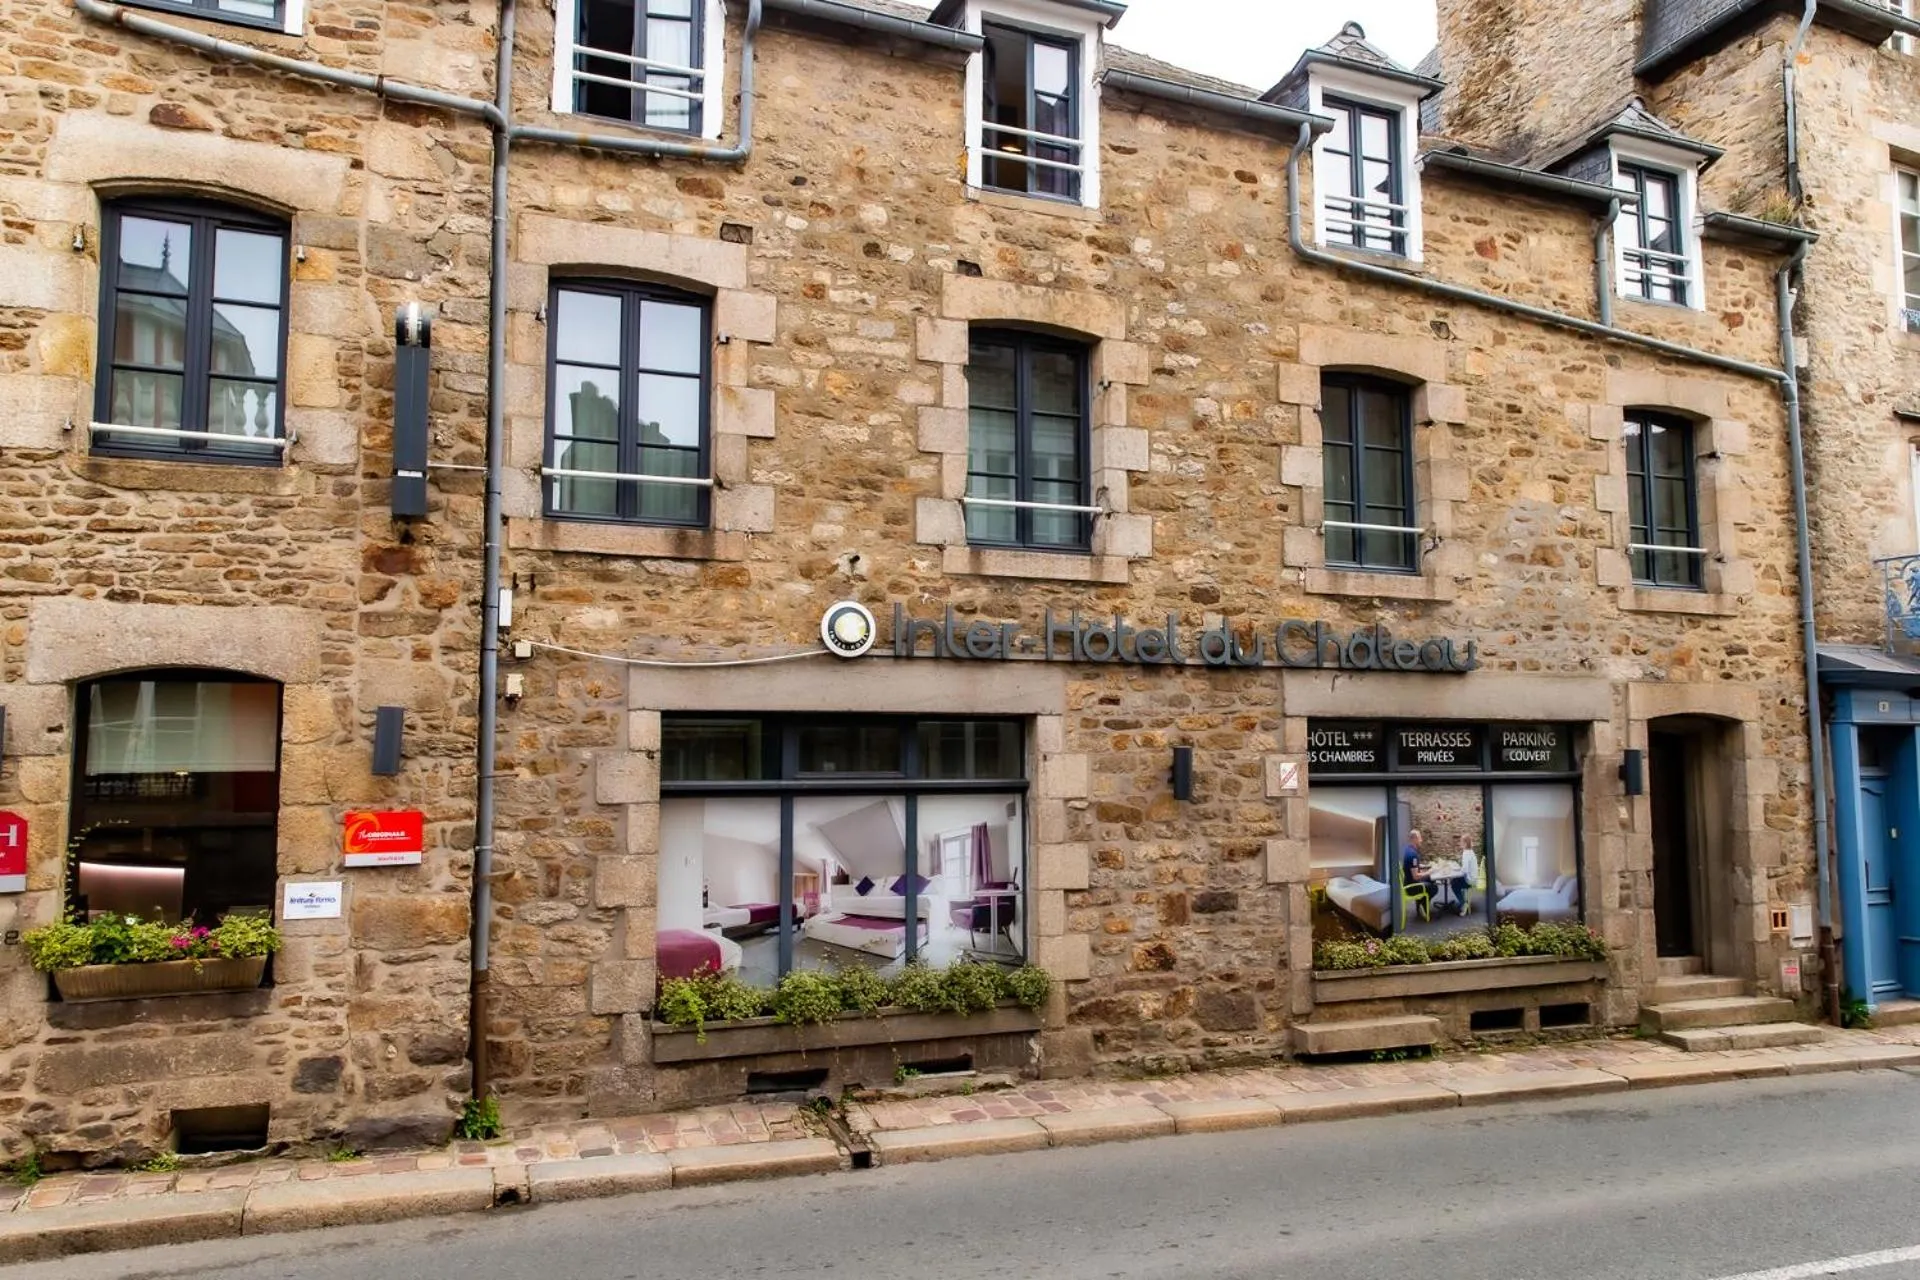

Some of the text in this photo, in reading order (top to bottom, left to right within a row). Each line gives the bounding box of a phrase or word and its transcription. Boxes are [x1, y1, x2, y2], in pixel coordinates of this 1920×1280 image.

[1200, 614, 1263, 667] du
[1307, 729, 1351, 746] HÔTEL
[1400, 731, 1472, 747] TERRASSES
[1503, 731, 1556, 746] PARKING
[1319, 750, 1376, 762] CHAMBRES
[1417, 748, 1455, 762] PRIVÉES
[1509, 750, 1551, 761] COUVERT
